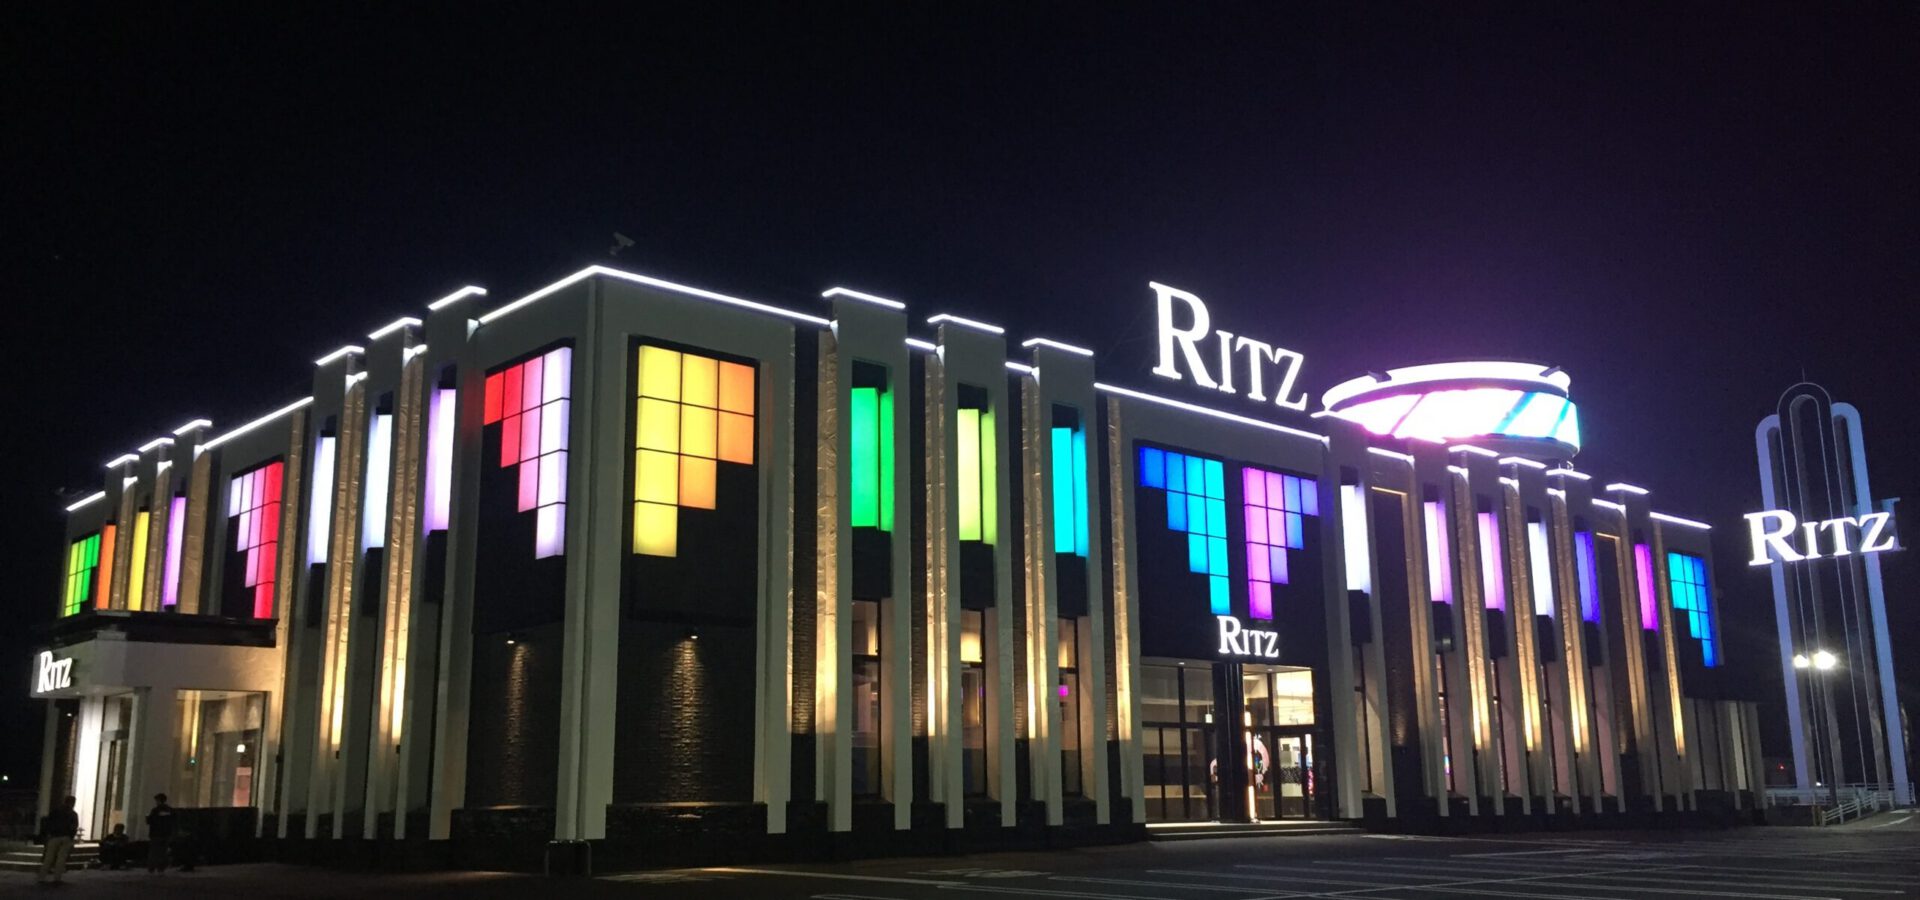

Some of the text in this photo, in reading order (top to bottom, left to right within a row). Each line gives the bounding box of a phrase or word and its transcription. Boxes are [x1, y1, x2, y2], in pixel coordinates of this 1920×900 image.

[1148, 280, 1308, 412] RITZ
[1743, 509, 1895, 566] RITZ
[1216, 615, 1279, 658] RITZ
[37, 651, 72, 693] RITZ
